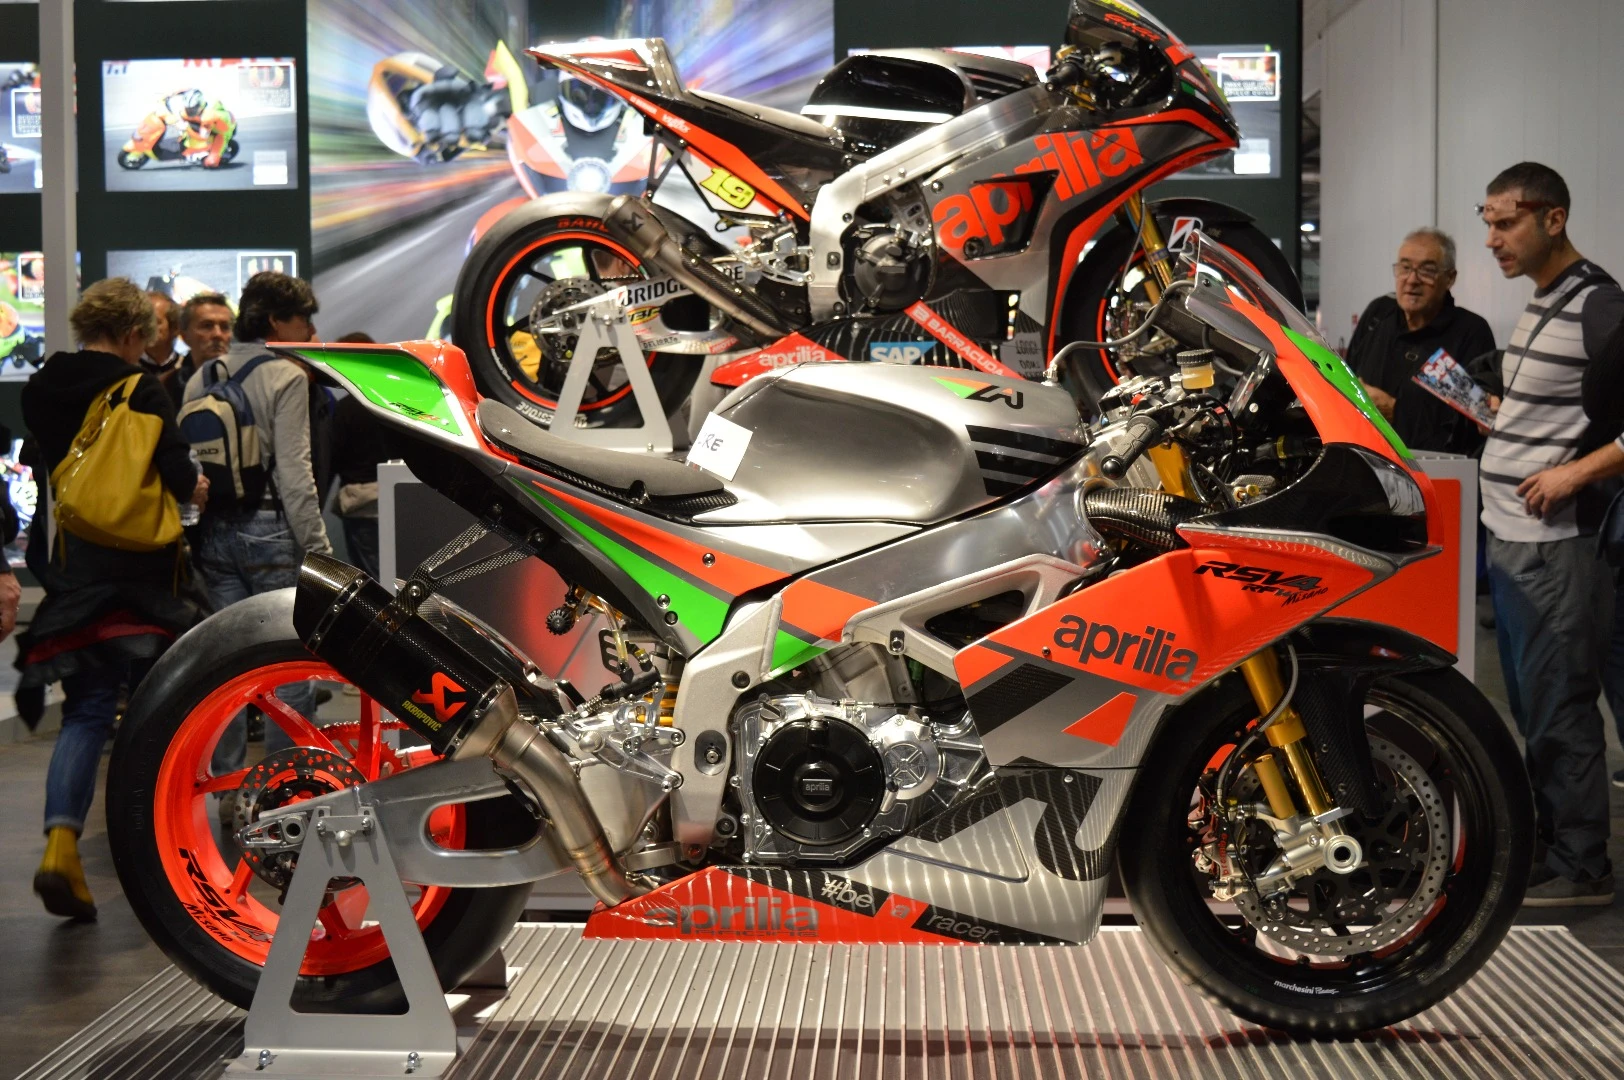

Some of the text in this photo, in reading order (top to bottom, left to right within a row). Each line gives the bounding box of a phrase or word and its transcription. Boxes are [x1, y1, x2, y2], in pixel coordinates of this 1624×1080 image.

[699, 167, 757, 210] 19
[931, 126, 1144, 250] aprilia
[758, 345, 826, 368] aprilia
[870, 345, 922, 365] SAP
[927, 318, 1005, 377] BARRACUDA
[1193, 560, 1323, 591] RSV4
[1281, 586, 1329, 608] Misano
[1053, 614, 1199, 683] aprilia
[805, 783, 830, 793] aprilia
[181, 901, 233, 942] Misano
[645, 896, 819, 934] aprilia
[821, 878, 1000, 942] #be a racer
[1274, 980, 1315, 995] marchesini
